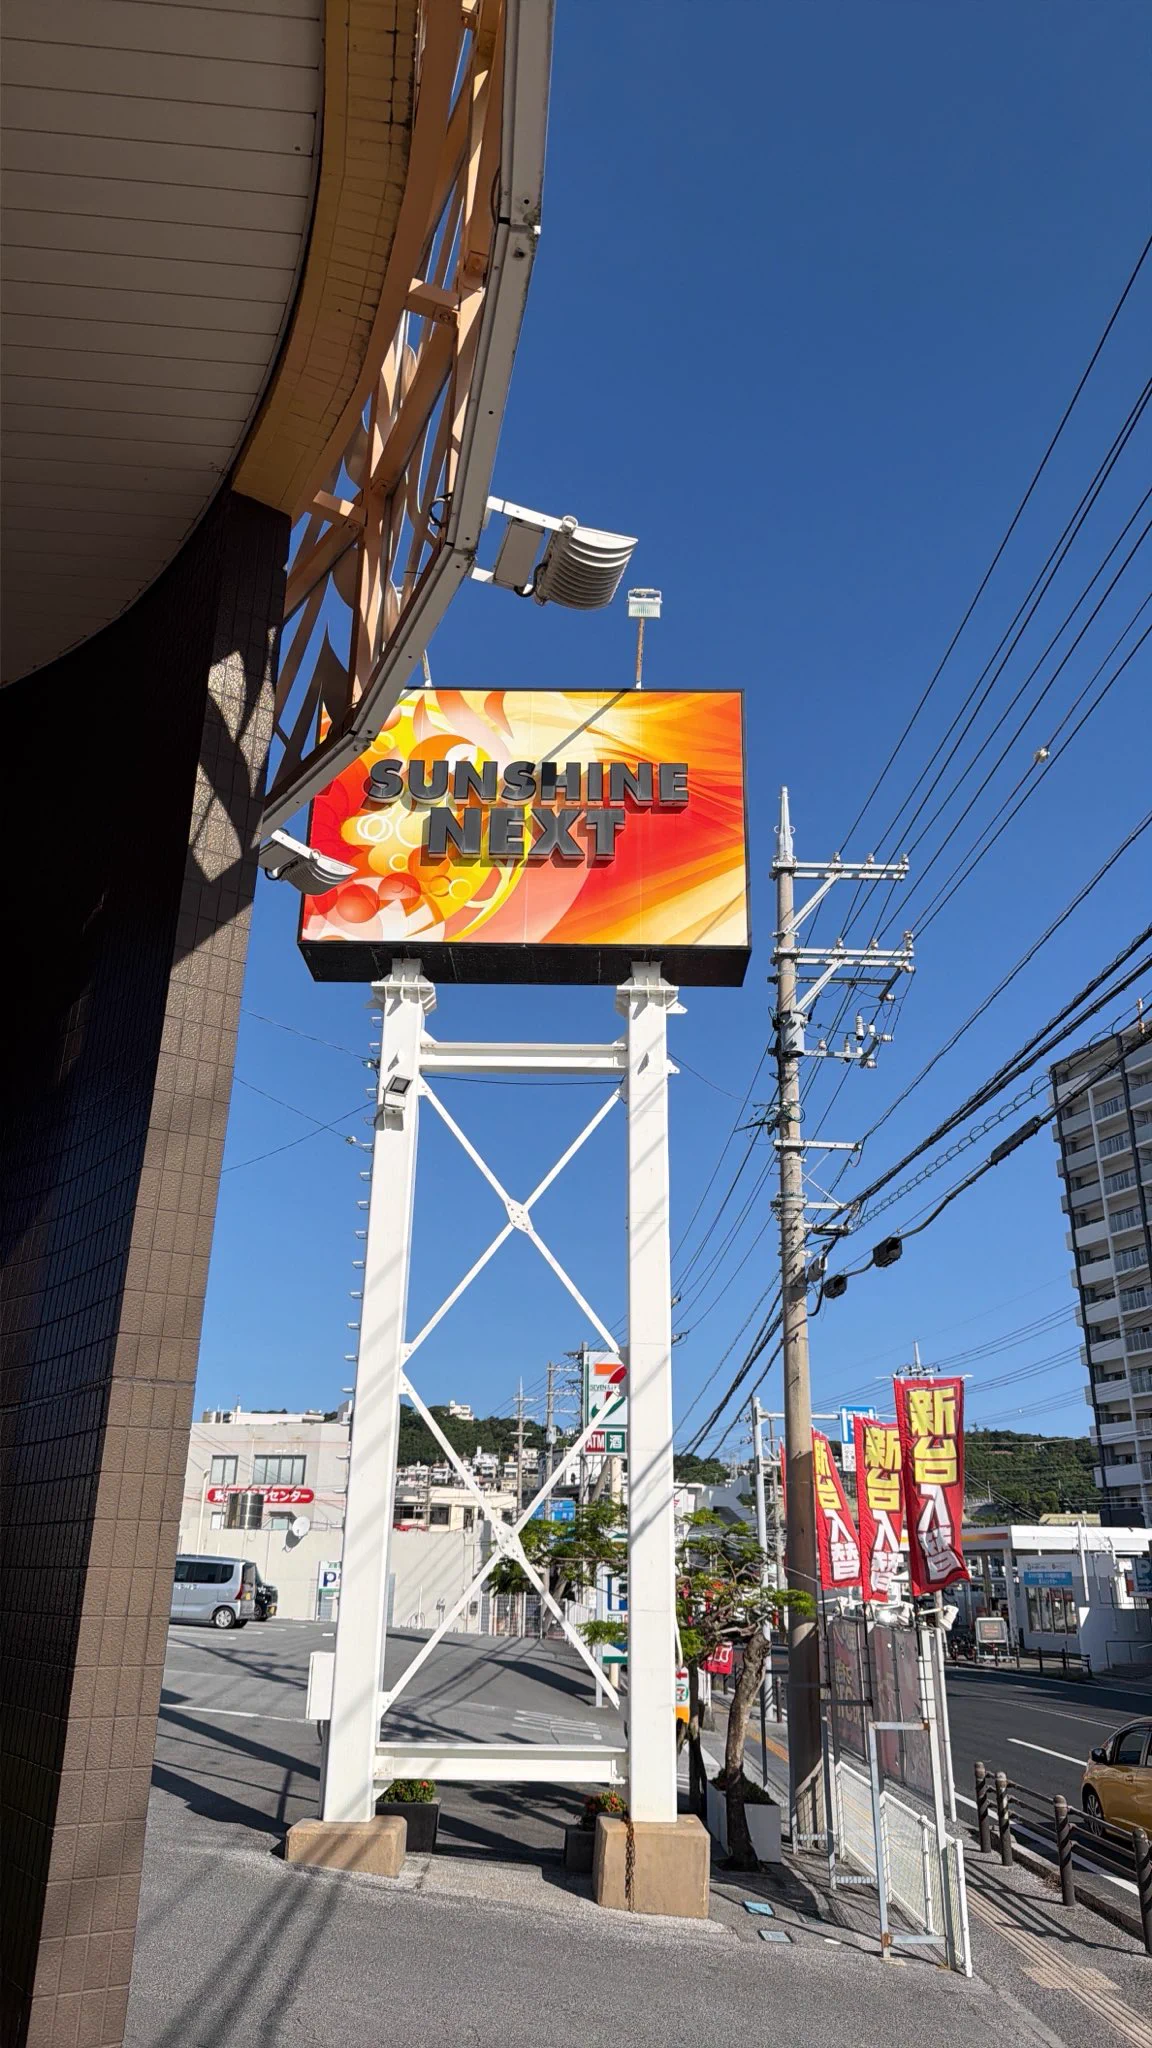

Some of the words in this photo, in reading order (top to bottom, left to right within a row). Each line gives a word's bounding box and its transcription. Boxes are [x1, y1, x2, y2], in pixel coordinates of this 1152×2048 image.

[366, 758, 689, 807] SUNSHINE
[427, 807, 626, 861] NEXT
[586, 1434, 605, 1449] ATM
[609, 1434, 623, 1450] 酒
[863, 1424, 904, 1592] 新台入替
[907, 1386, 963, 1582] 新台入替
[813, 1438, 861, 1582] 新台入替
[322, 1571, 337, 1587] P
